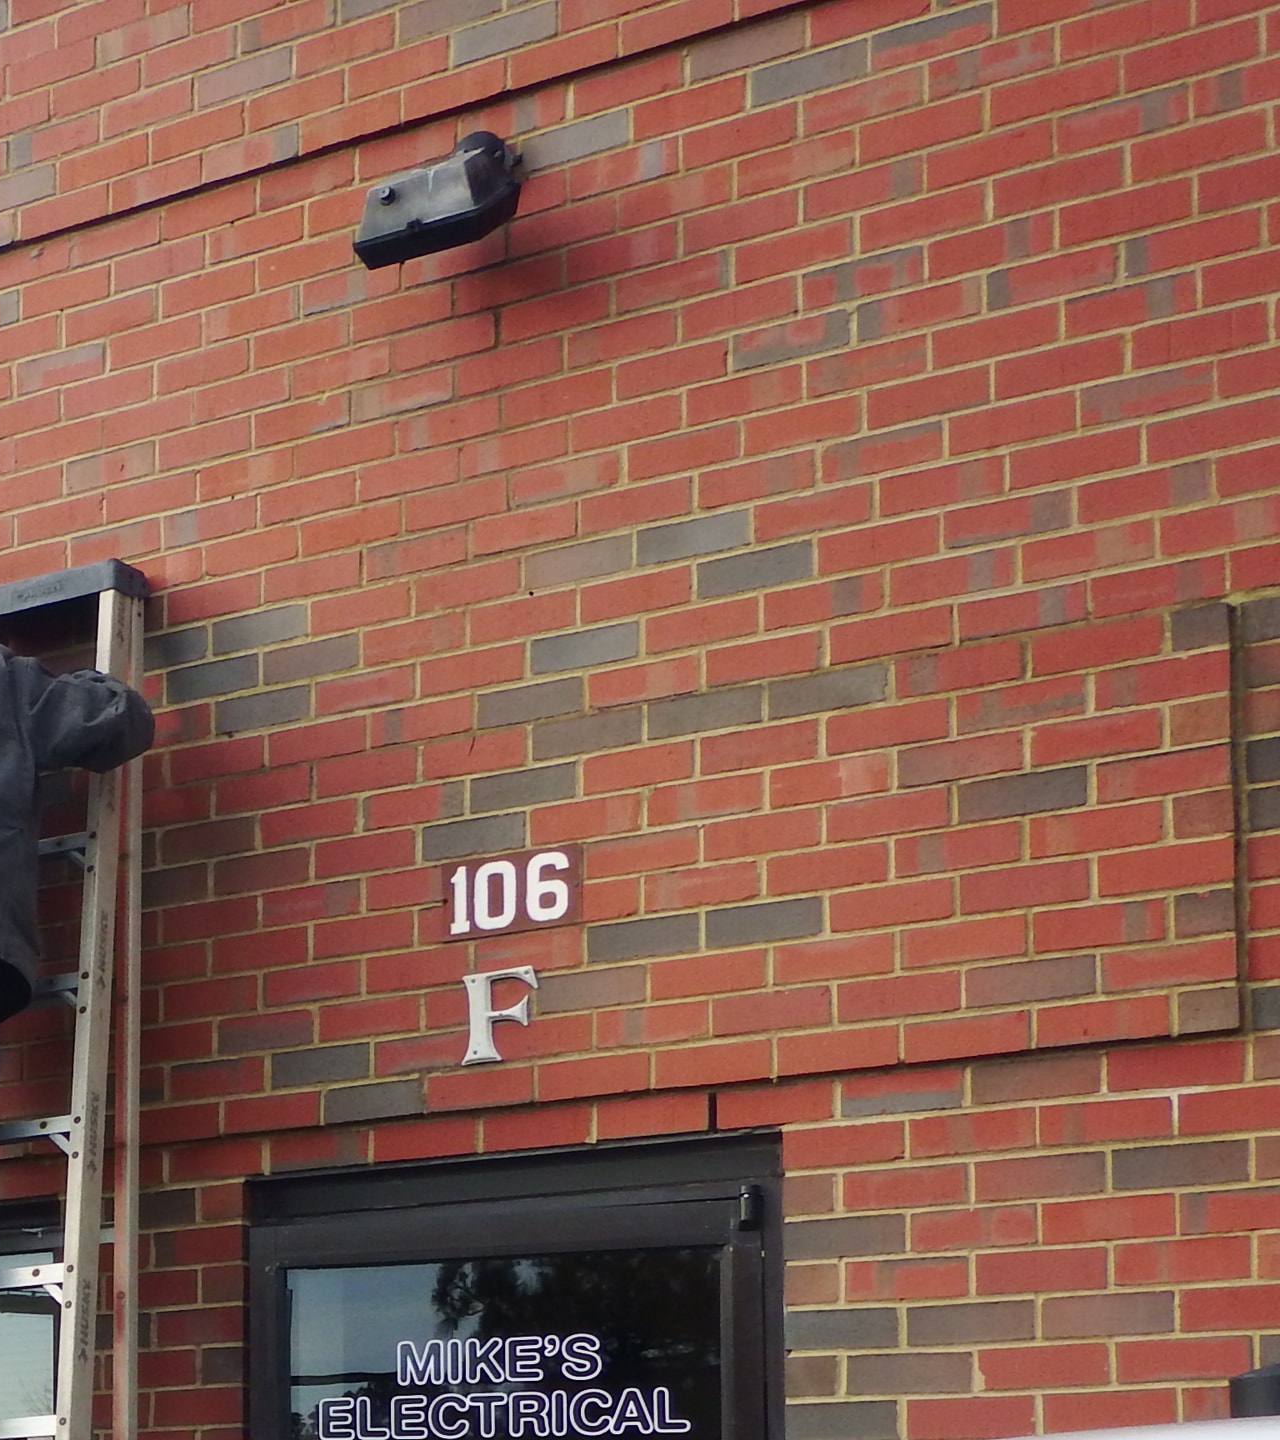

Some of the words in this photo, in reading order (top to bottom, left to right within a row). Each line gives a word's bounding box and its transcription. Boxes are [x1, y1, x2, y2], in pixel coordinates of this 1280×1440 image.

[449, 851, 571, 935] 106
[461, 965, 538, 1066] F
[397, 1333, 602, 1386] MIKE'S
